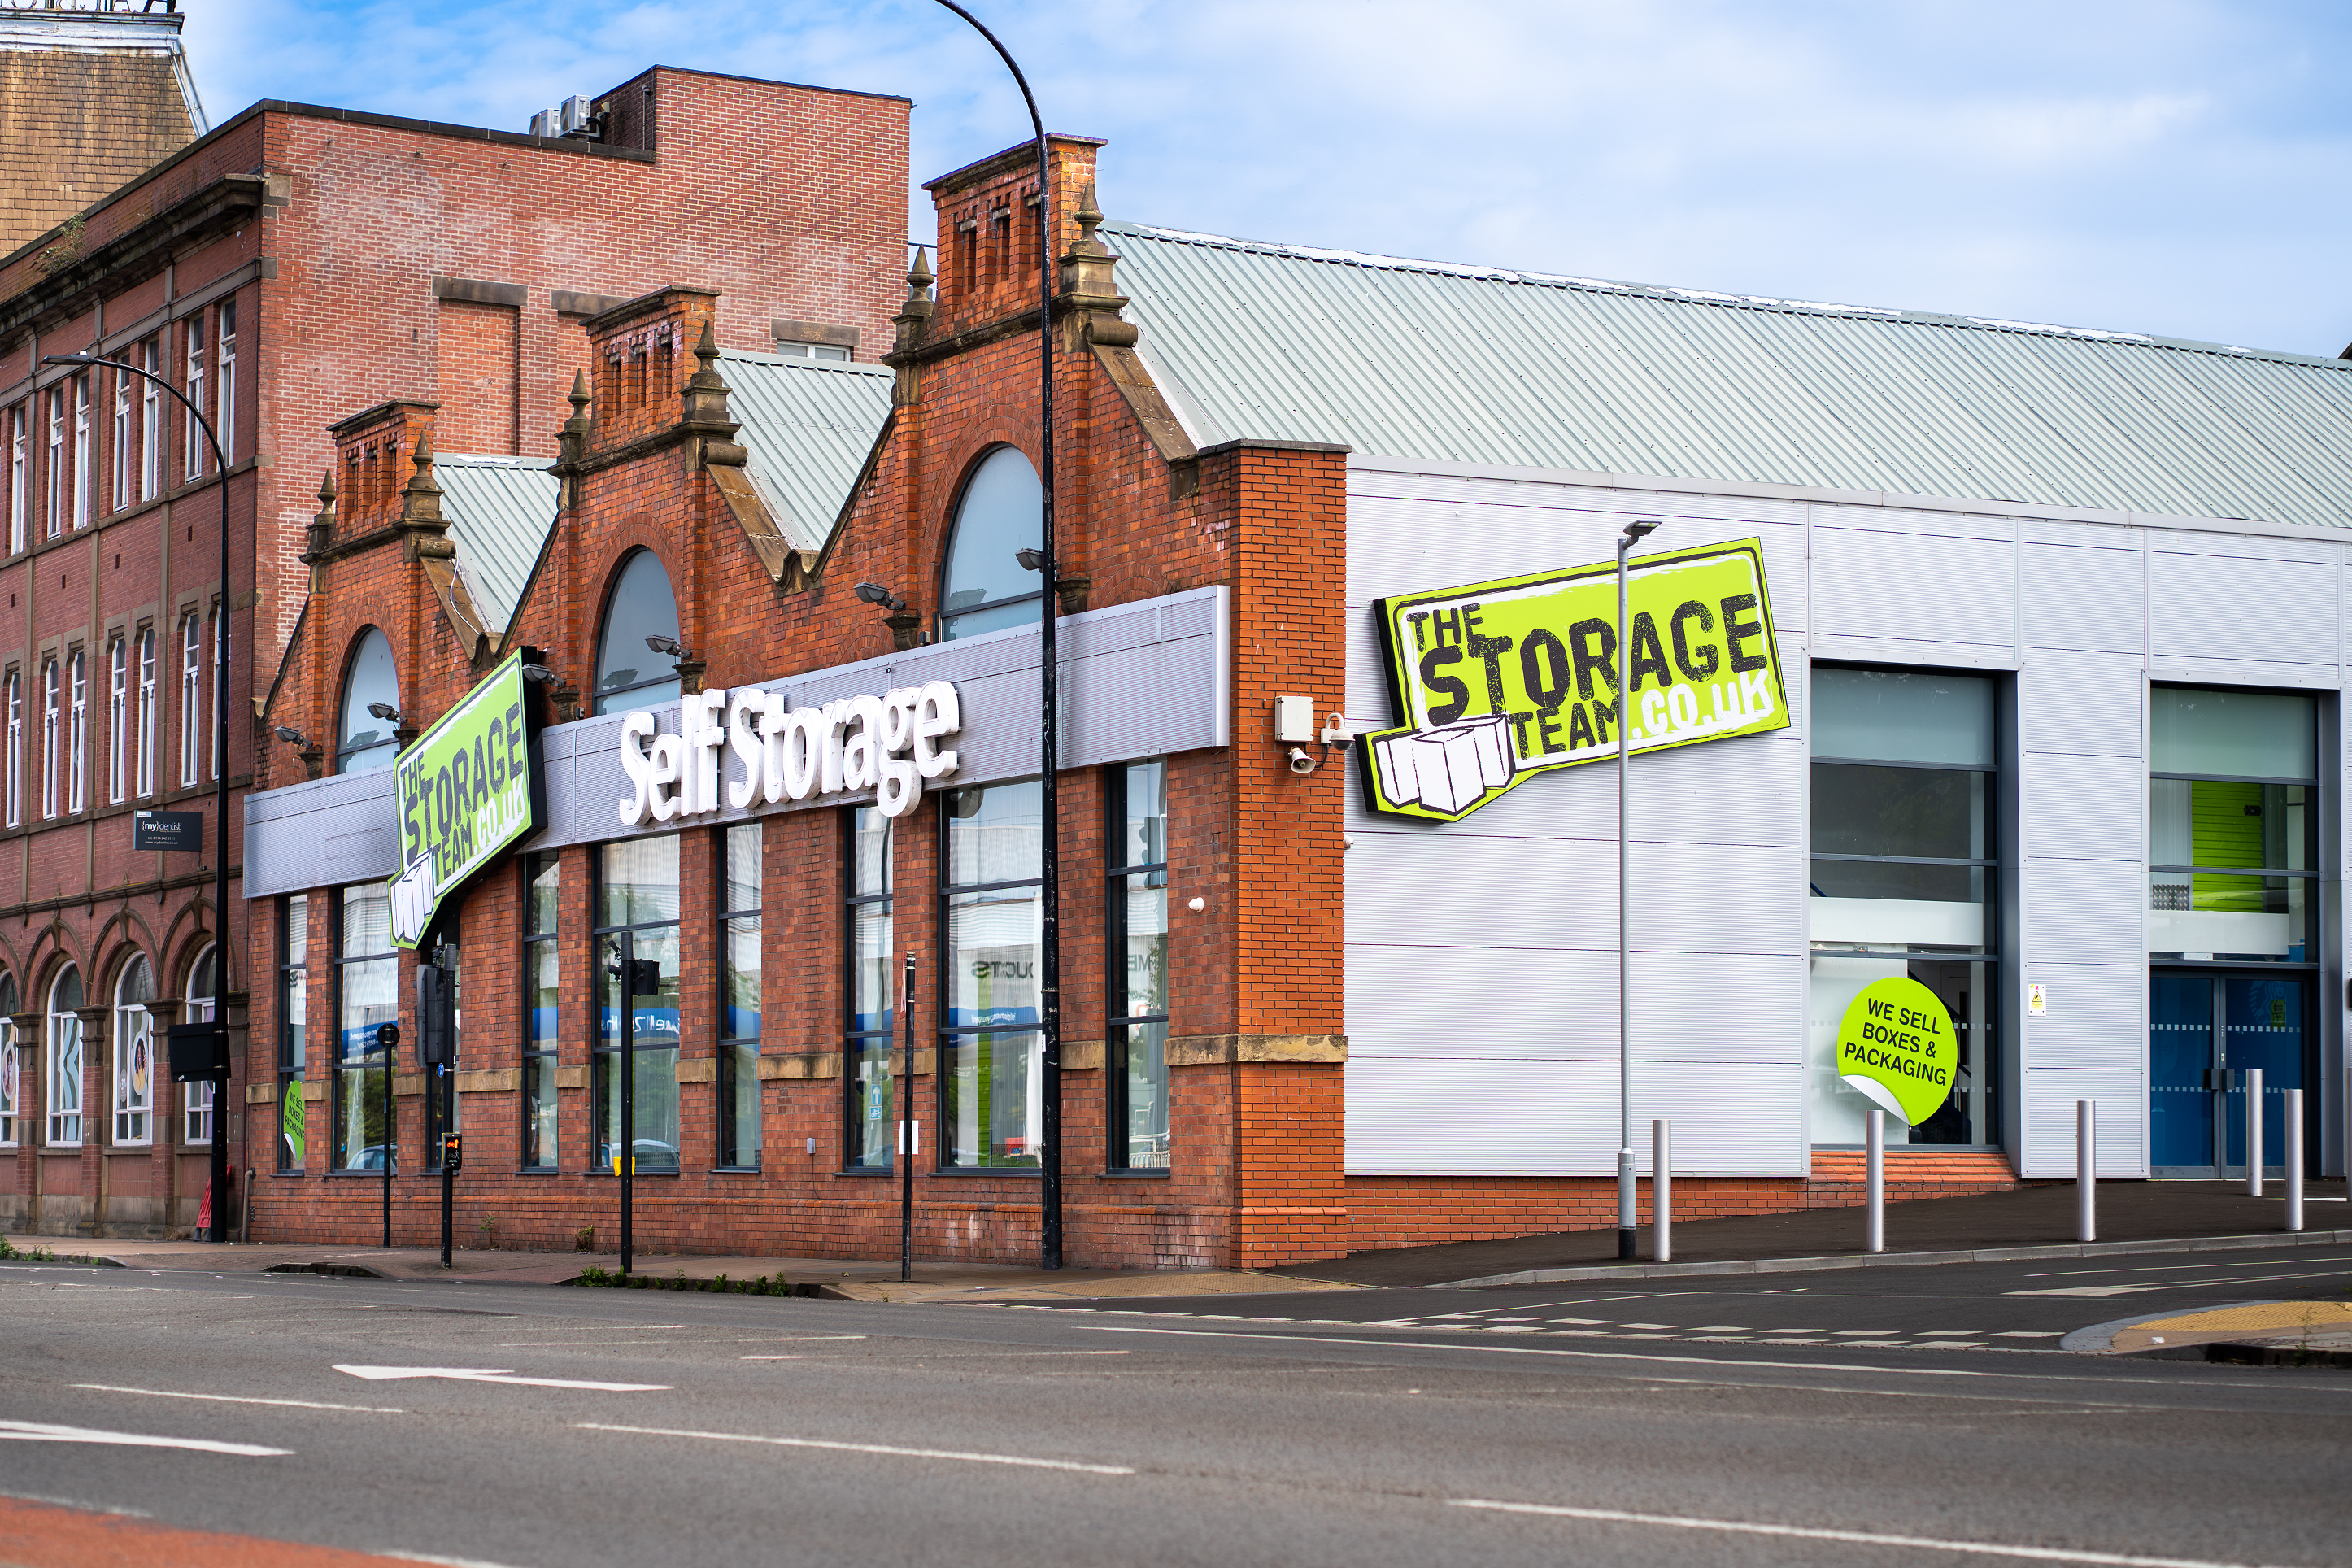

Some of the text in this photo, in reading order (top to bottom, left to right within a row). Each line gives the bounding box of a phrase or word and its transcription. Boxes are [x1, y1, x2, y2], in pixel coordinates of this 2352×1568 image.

[1406, 603, 1485, 651] THE
[1419, 593, 1768, 726] STORAGE
[400, 751, 425, 799] THE
[619, 680, 960, 826] Self Storage
[404, 701, 525, 867] STORAGE
[1862, 1021, 1936, 1058] BOXES &
[1868, 998, 1941, 1035] WE SELL
[1844, 1041, 1947, 1087] PACKAGING
[288, 1104, 301, 1124] BOXES
[290, 1091, 305, 1113] WE SELL
